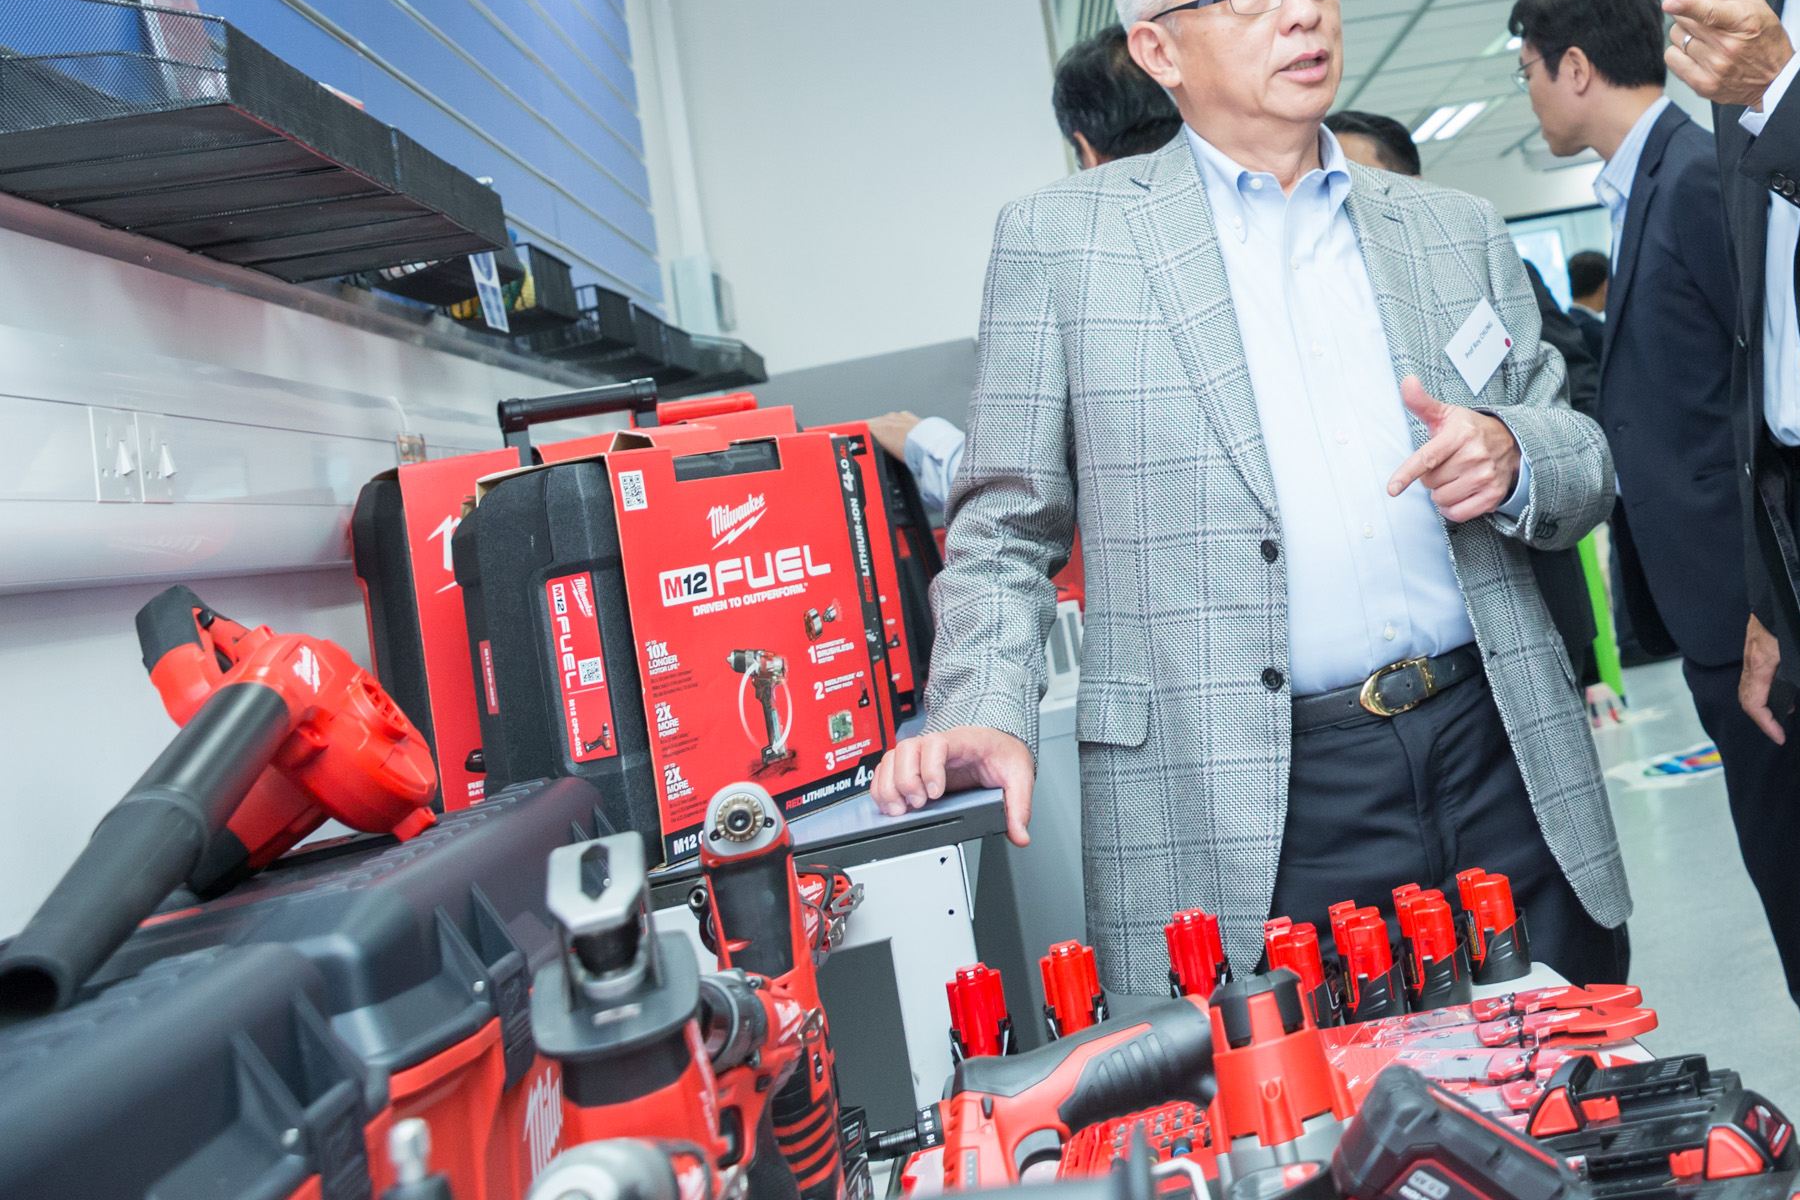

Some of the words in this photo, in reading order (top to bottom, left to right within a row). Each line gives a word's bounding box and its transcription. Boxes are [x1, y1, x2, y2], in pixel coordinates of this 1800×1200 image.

[706, 493, 766, 539] Milwaukee
[663, 571, 708, 600] M12
[715, 545, 832, 596] FUEL
[553, 586, 566, 612] M12
[573, 576, 594, 618] Milwaukee
[692, 600, 728, 616] DRIVEN
[728, 596, 742, 608] TO
[556, 616, 577, 689] FUEL
[646, 642, 669, 660] 10X
[808, 645, 816, 664] 1
[648, 654, 678, 669] LONGER
[649, 666, 668, 676] MOTOR
[814, 681, 825, 700] 2
[568, 699, 577, 716] M12
[656, 704, 672, 722] 2X
[658, 718, 679, 732] MORE
[824, 752, 835, 770] 3
[664, 766, 682, 785] 2X
[666, 779, 690, 794] MORE
[786, 778, 852, 810] REDLITHIUM-ION
[854, 766, 874, 786] 4.0
[673, 834, 698, 855] M12
